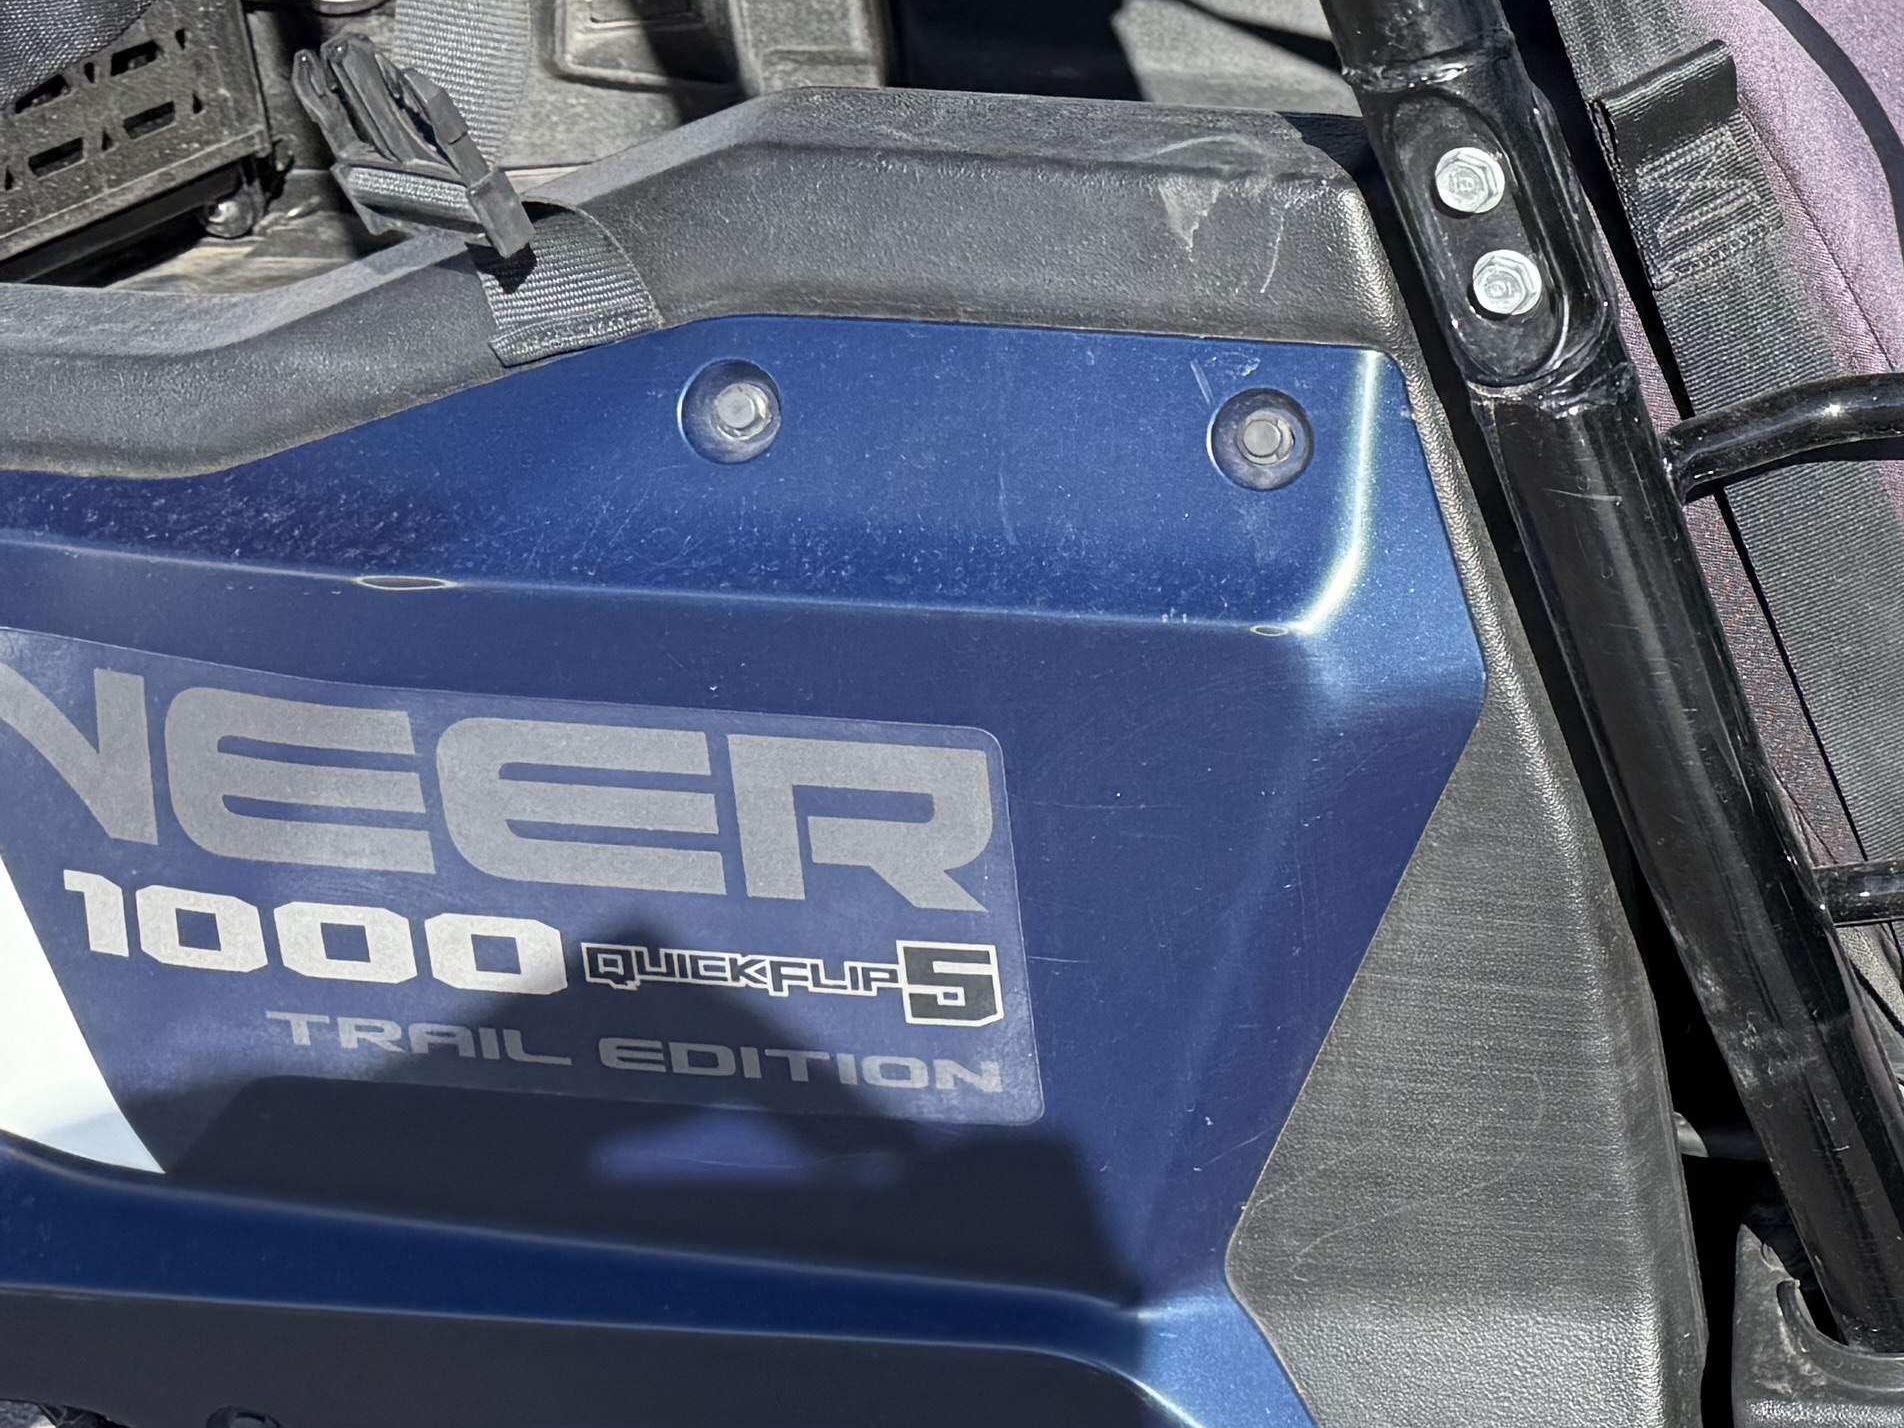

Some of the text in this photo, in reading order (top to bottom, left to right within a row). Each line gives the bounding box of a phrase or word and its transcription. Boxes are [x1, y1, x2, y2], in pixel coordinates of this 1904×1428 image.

[63, 869, 568, 995] 1000
[266, 1011, 1003, 1093] TRAIL EDITION
